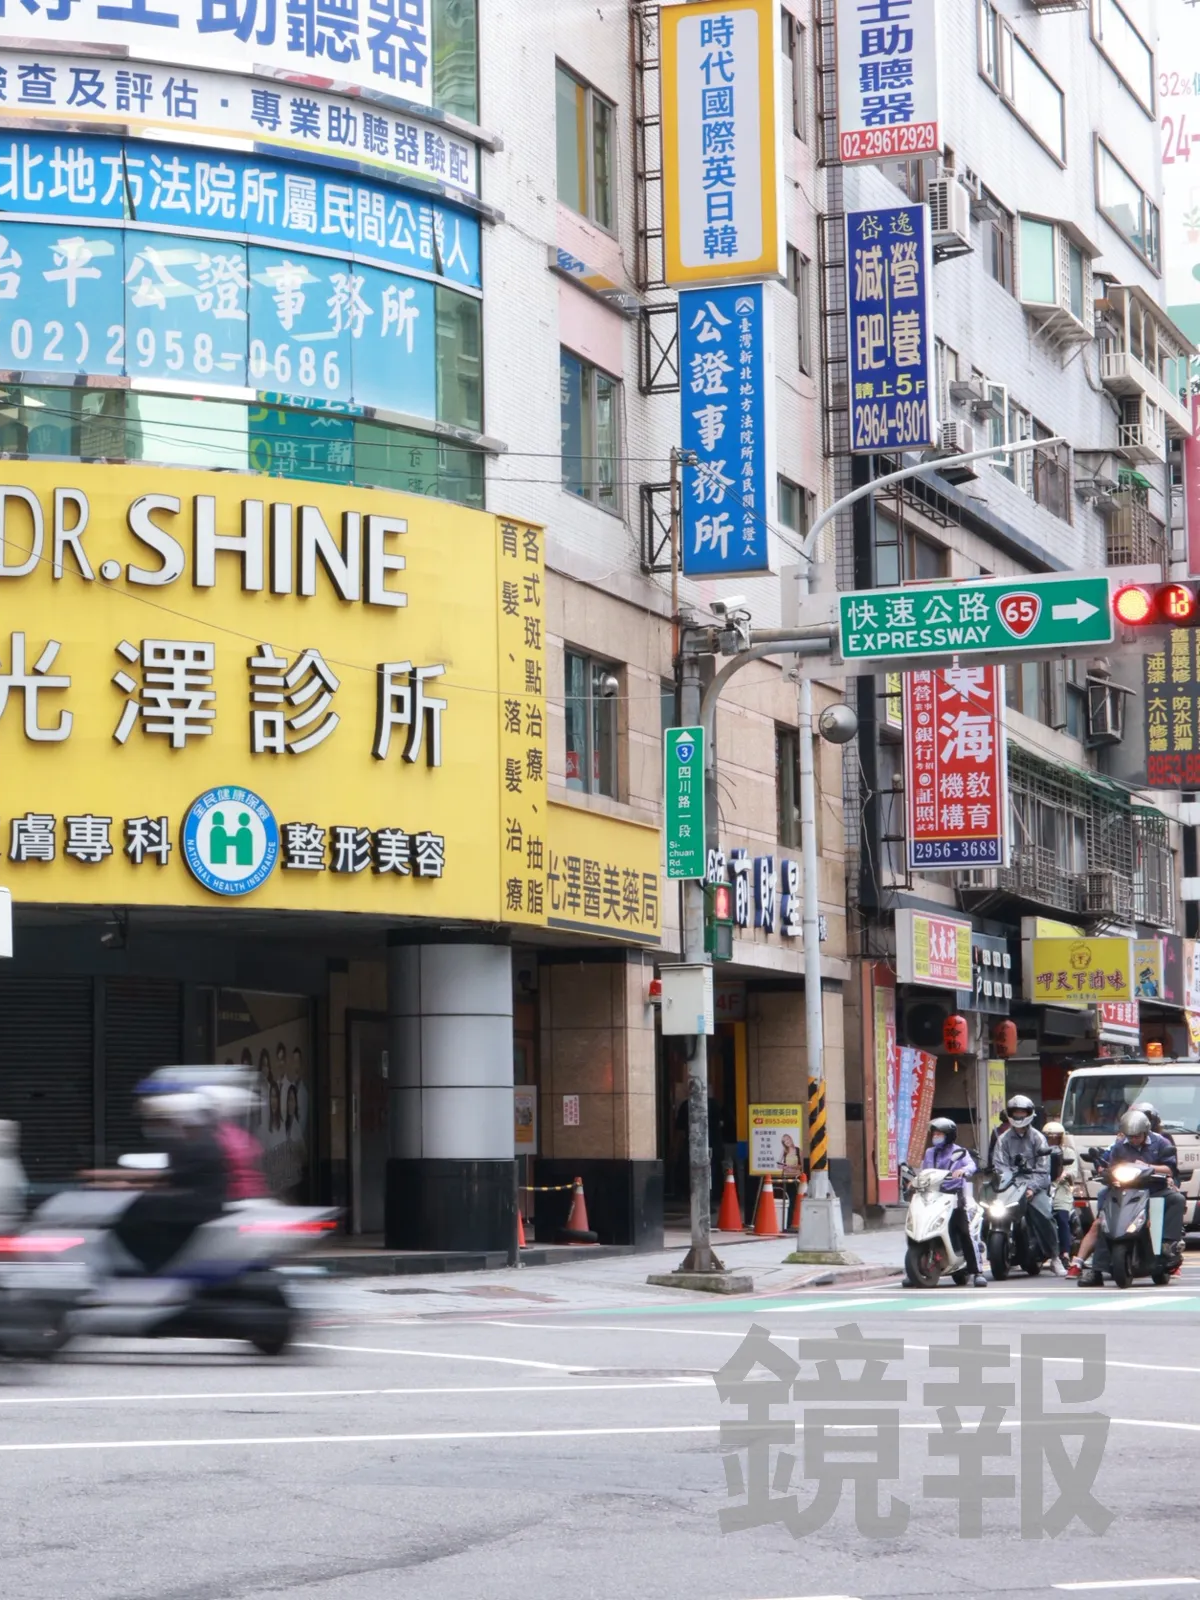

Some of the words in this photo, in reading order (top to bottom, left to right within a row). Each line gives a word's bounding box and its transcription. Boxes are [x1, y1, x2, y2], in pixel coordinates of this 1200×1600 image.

[700, 15, 738, 259] 時代國際英日韓
[842, 130, 935, 159] 02-29612929
[854, 244, 885, 371] 減肥
[889, 241, 921, 367] 營養
[689, 300, 736, 560] 公證事務所
[855, 400, 928, 447] 2964-9301
[848, 592, 990, 631] 快速公路
[1005, 602, 1034, 623] 65
[848, 626, 991, 652] EXPRESSWAY
[500, 522, 524, 912] 育髮、落髮治療
[522, 527, 545, 915] 各式斑點治療、抽脂
[681, 748, 689, 758] 3
[678, 766, 692, 838] 四川路一段
[187, 839, 211, 883] NATIONAL
[212, 879, 246, 892] HEALTH
[246, 841, 277, 888] INSURANCE
[282, 821, 446, 879] 整形美容
[669, 868, 687, 876] Sec.
[916, 840, 996, 859] 2956-3688
[546, 849, 659, 930] 光澤醫美藥局
